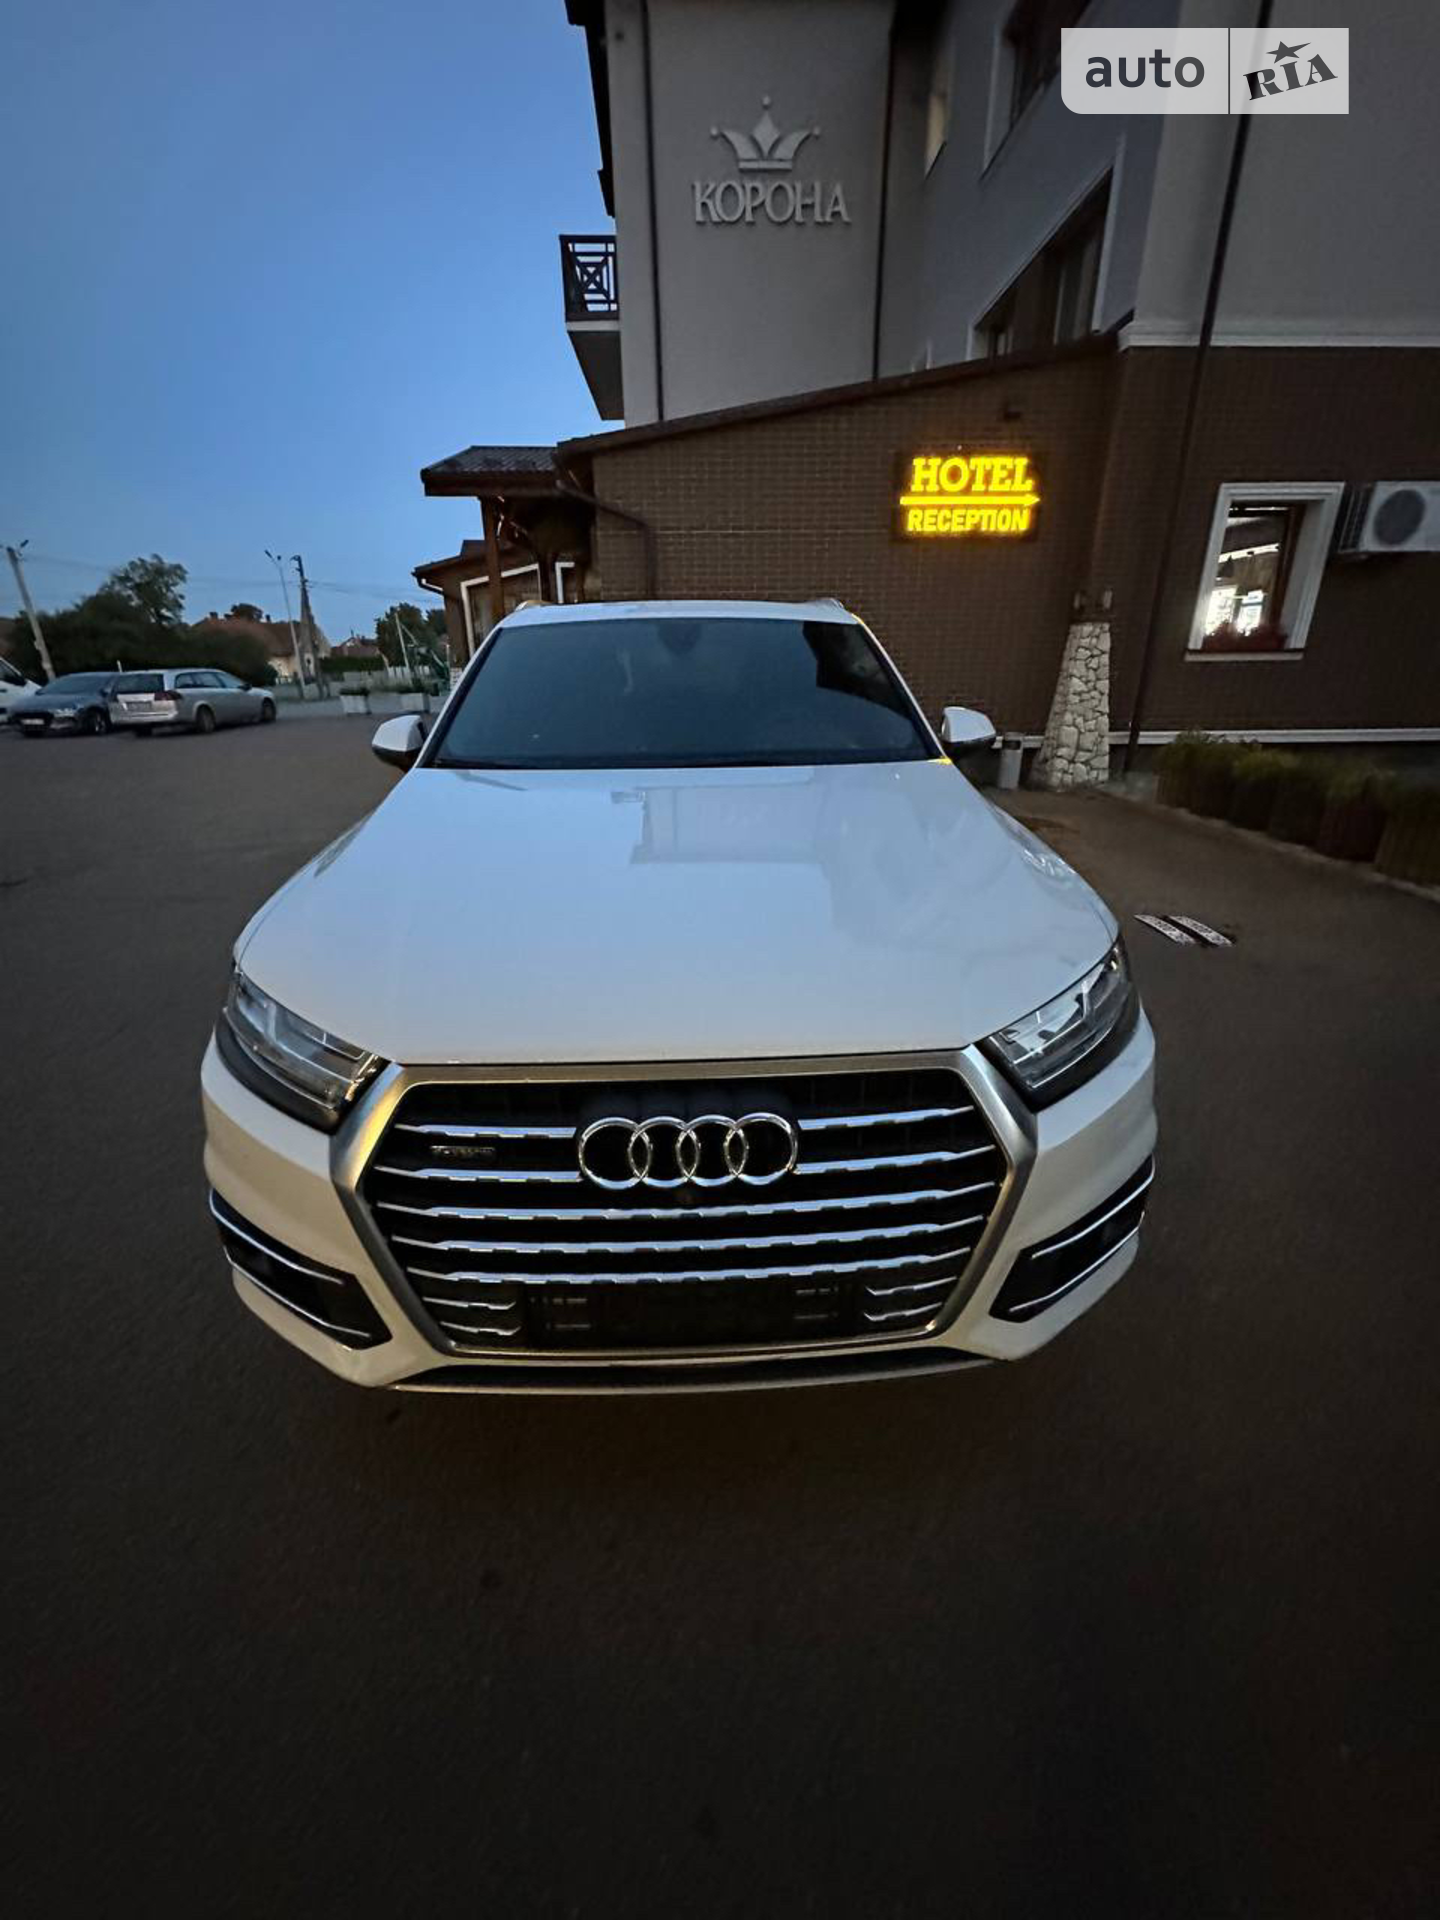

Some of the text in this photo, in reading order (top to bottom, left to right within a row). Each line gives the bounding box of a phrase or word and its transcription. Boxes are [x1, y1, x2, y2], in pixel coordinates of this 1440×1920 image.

[692, 180, 851, 224] КОРОНА
[910, 456, 1034, 493] HOTEL
[907, 508, 1030, 533] RECEPTION
